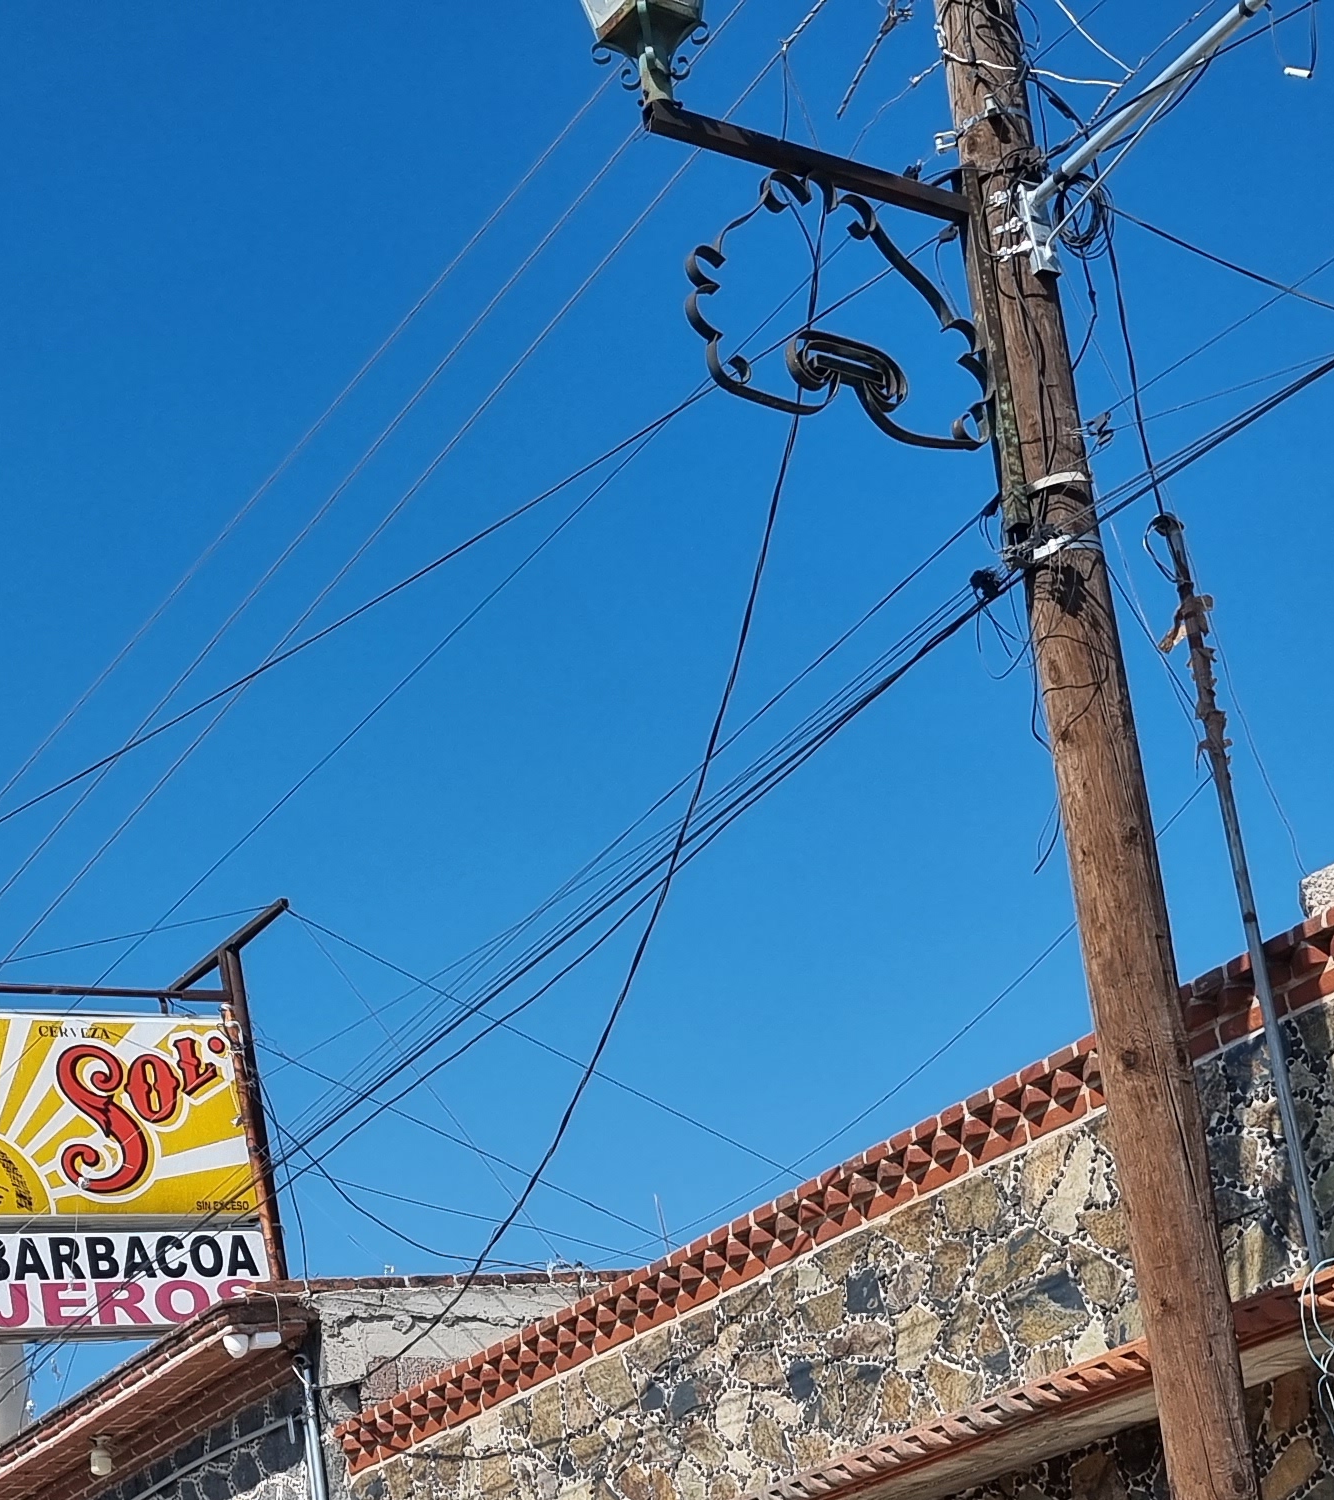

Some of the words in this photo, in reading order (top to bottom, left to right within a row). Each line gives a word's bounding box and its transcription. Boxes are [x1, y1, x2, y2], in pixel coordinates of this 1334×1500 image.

[38, 1025, 110, 1040] CERVEZA
[196, 1200, 211, 1211] SIN
[213, 1200, 250, 1211] EXCESO
